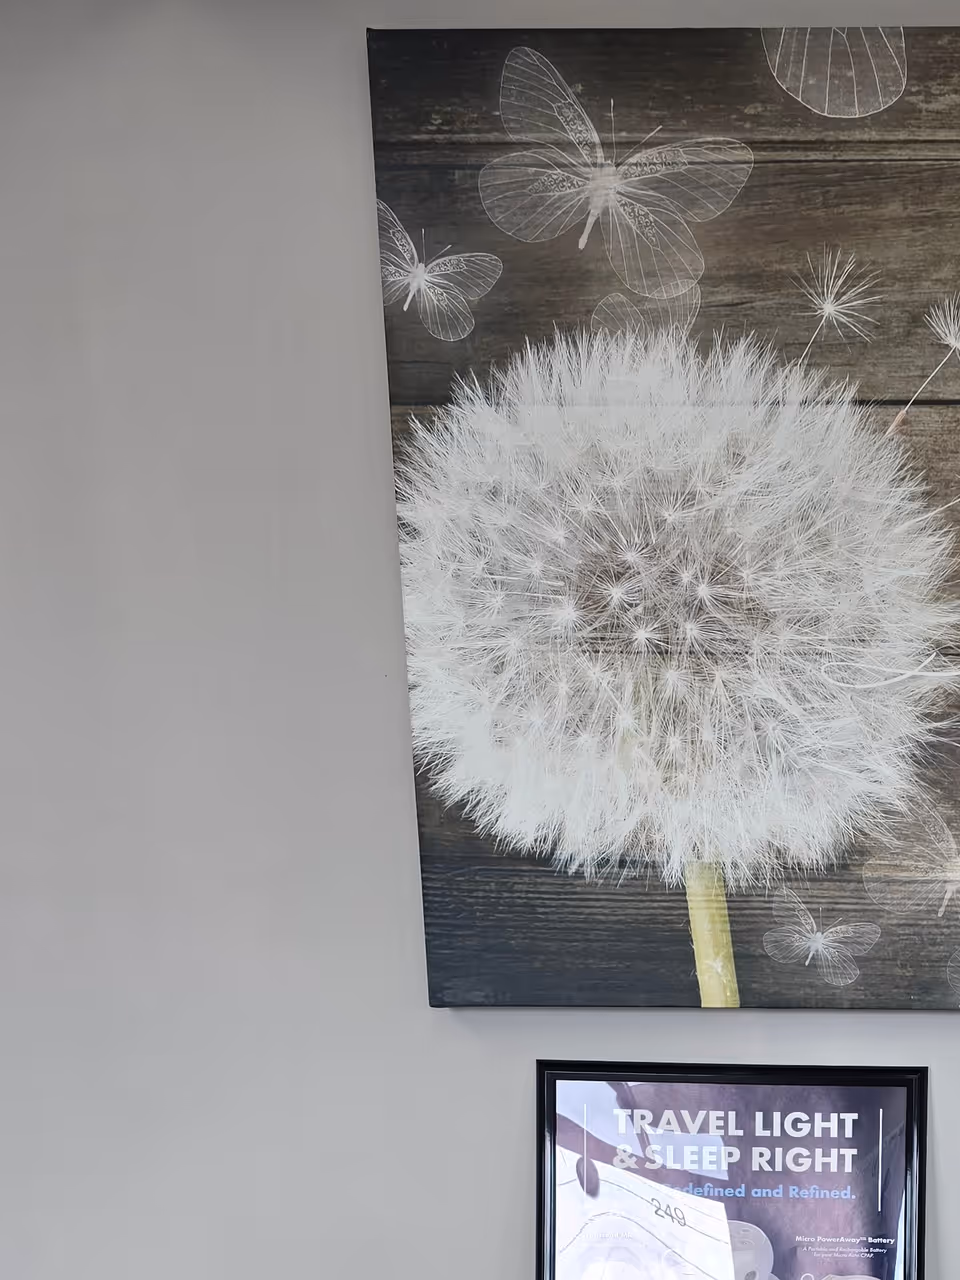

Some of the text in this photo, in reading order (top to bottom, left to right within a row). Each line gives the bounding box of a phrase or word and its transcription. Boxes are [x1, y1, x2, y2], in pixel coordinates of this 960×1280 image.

[612, 1108, 859, 1138] TRAVEL LIGHT
[612, 1144, 858, 1173] & SLEEP RIGHT
[751, 1184, 856, 1199] and Refined.
[867, 1237, 895, 1245] Battery
